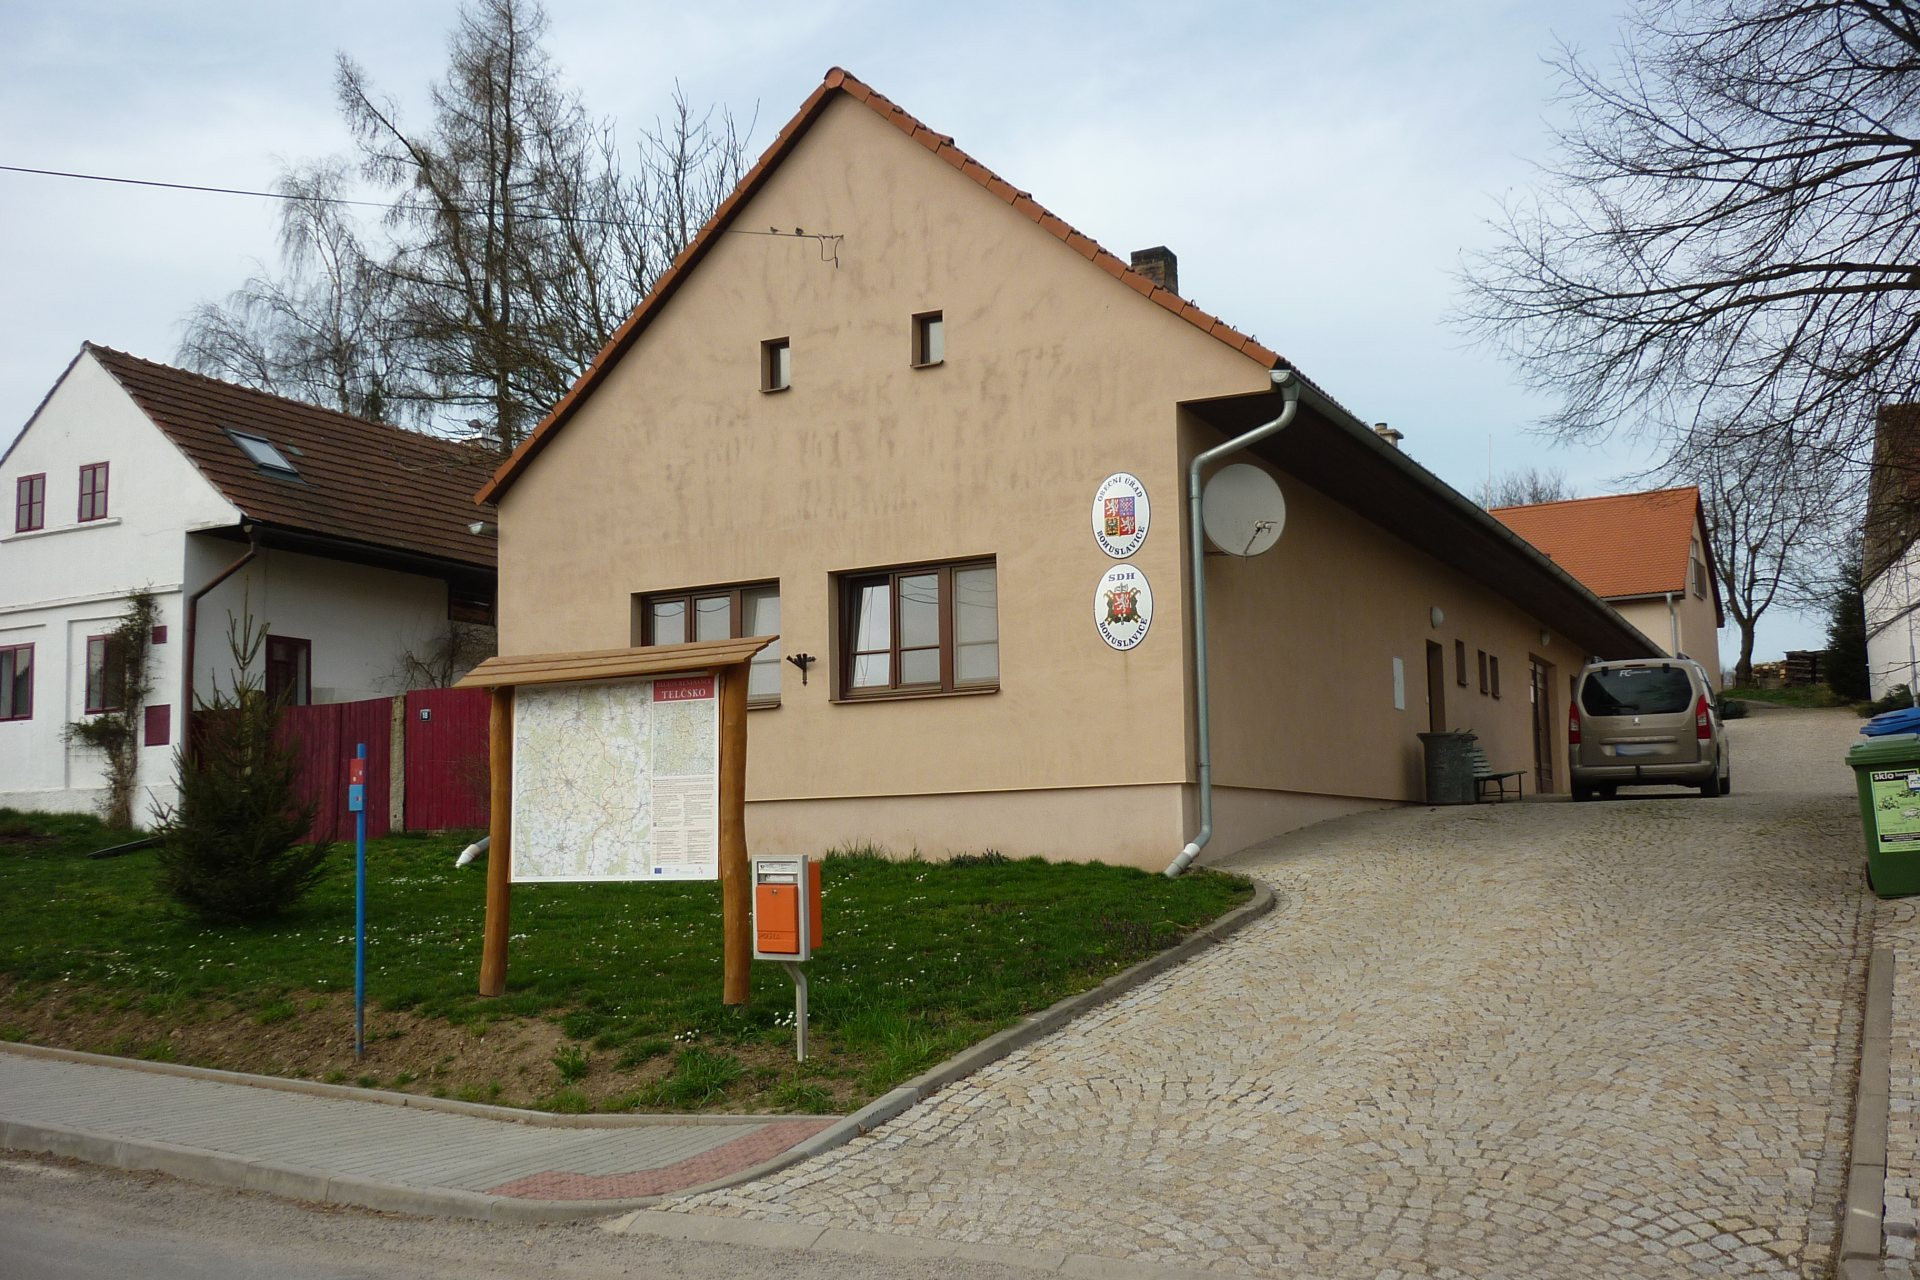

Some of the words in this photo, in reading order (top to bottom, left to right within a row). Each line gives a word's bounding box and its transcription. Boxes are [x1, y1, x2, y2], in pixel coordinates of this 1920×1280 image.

[1097, 476, 1122, 502] OBECNÍ
[1124, 477, 1143, 498] ÚŘAD
[1096, 525, 1145, 556] BOHUSLAVICE
[1108, 572, 1135, 582] SDH
[1099, 617, 1148, 647] BOHUSLAVICE
[661, 688, 706, 699] TELČSKO
[1874, 772, 1895, 780] sklo
